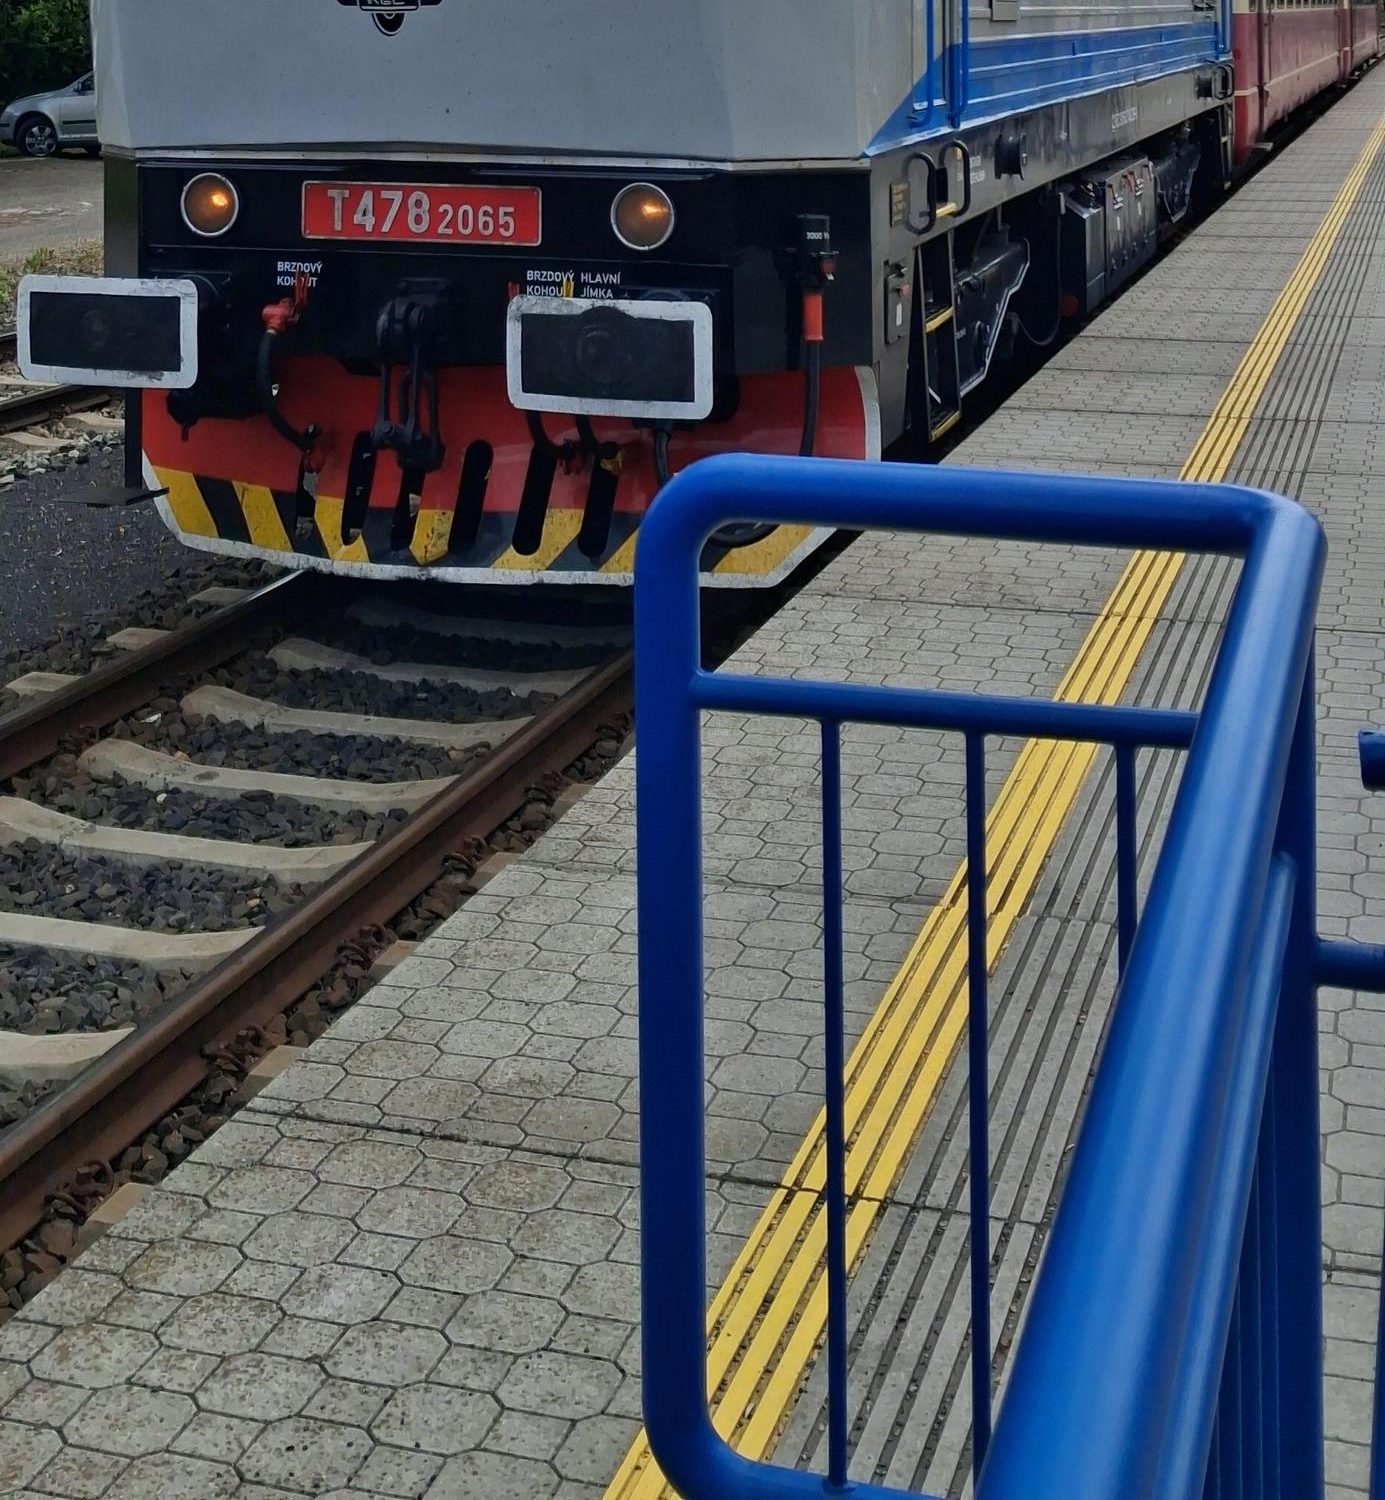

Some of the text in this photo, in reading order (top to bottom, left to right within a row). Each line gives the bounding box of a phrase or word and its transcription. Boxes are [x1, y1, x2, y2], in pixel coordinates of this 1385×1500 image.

[327, 189, 515, 237] T478 2065
[277, 261, 323, 274] BRZDOVÝ
[526, 269, 622, 285] BRZDOVÝ HLAVNÍ
[526, 284, 614, 299] KOHOU JÍMKA
